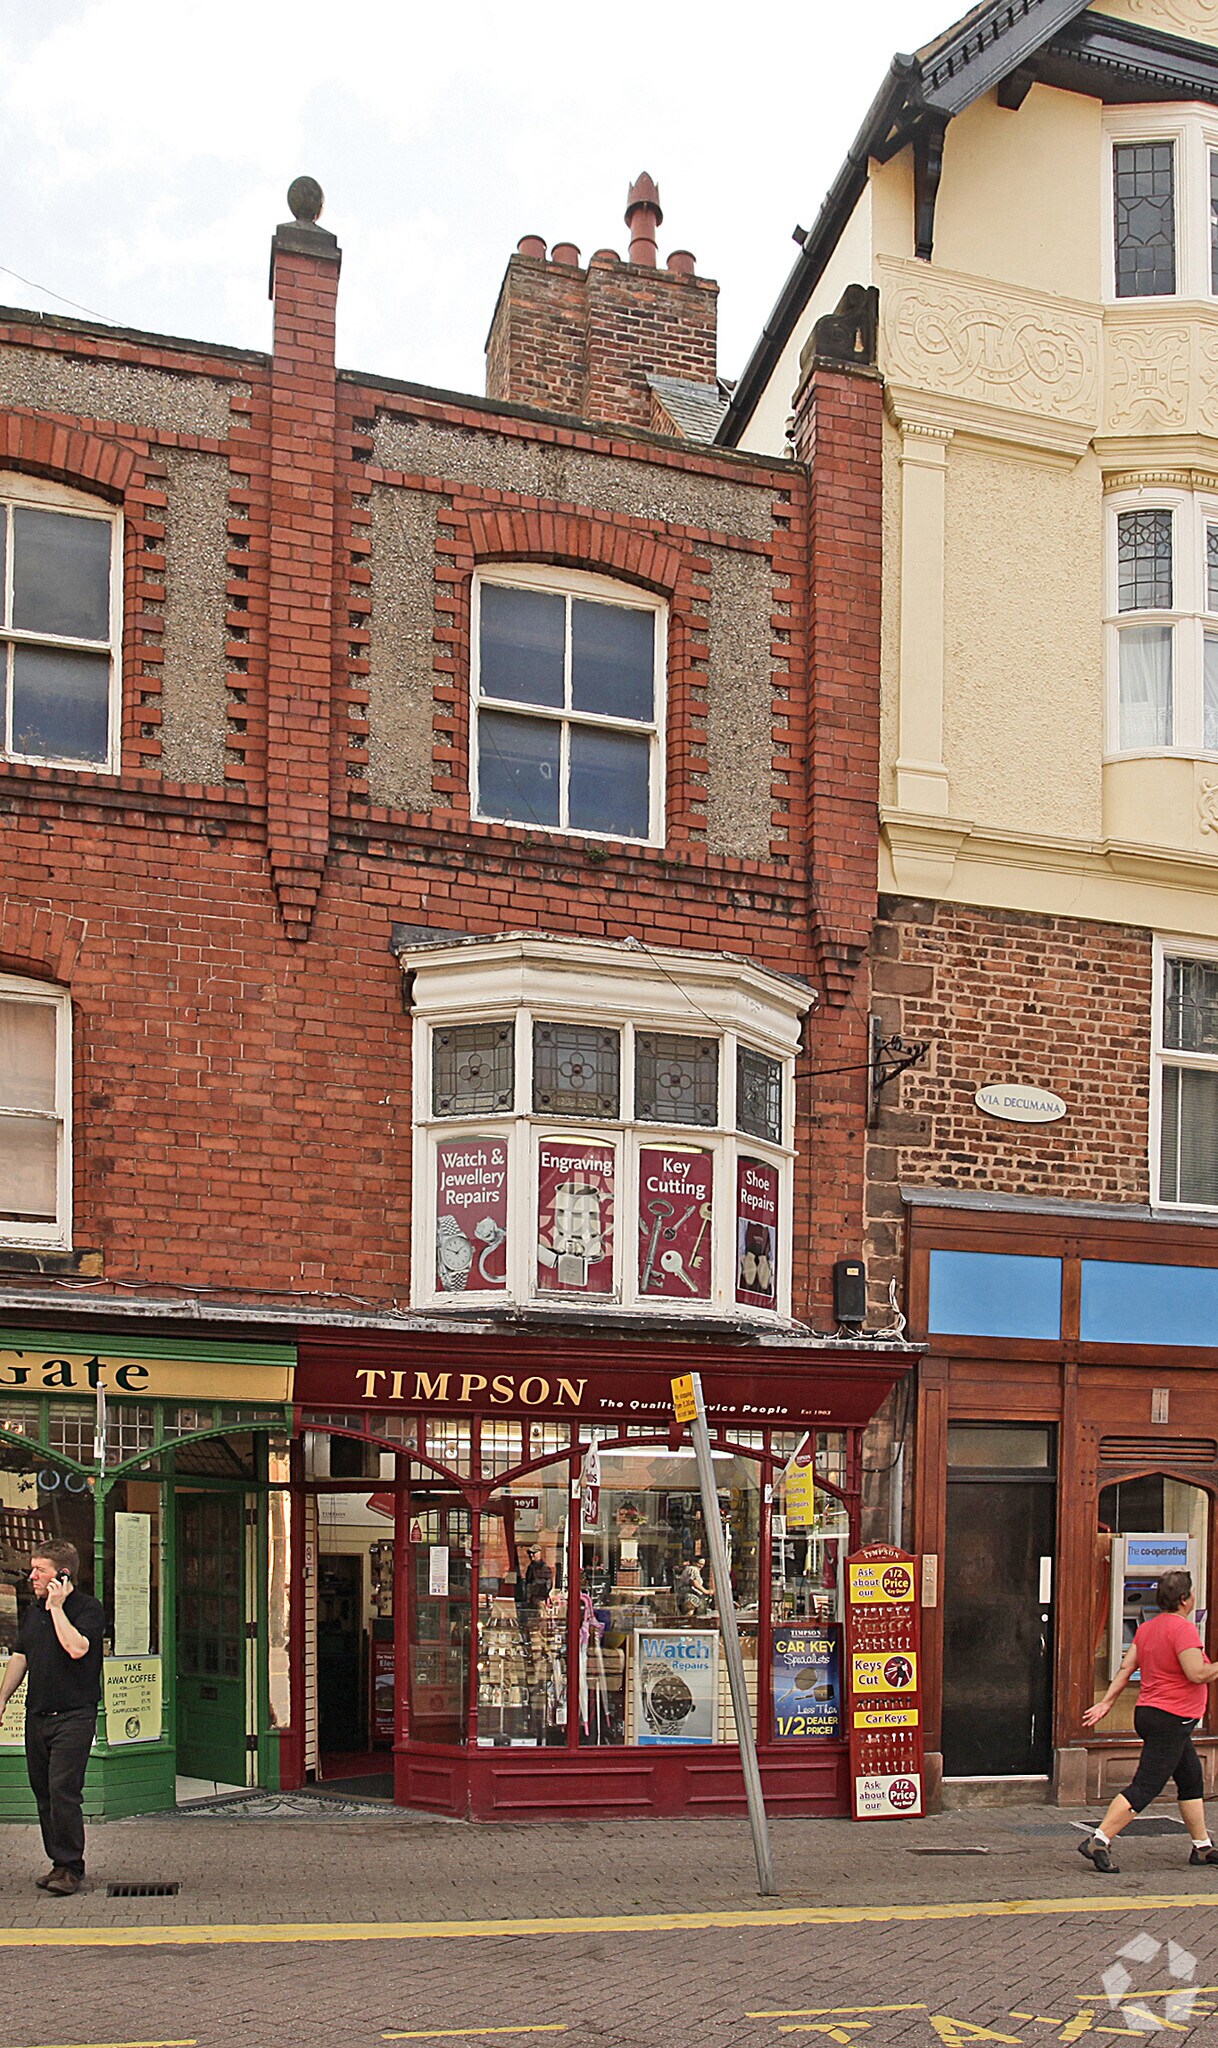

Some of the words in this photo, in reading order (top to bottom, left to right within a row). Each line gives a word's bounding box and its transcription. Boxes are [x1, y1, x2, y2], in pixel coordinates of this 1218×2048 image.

[981, 1094, 1000, 1106] VIA
[1004, 1097, 1061, 1113] DECUMANA
[441, 1150, 487, 1168] Watch
[491, 1148, 504, 1165] &
[541, 1152, 613, 1176] Engraving
[663, 1157, 691, 1178] Key
[440, 1169, 506, 1190] Jewellery
[746, 1170, 770, 1191] Shoe
[646, 1176, 706, 1200] Cutting
[446, 1189, 499, 1208] Repairs
[740, 1188, 775, 1213] Repairs
[356, 1369, 588, 1406] TIMPSON
[600, 1399, 624, 1408] The
[742, 1405, 788, 1414] People
[862, 1547, 900, 1558] TIMPSON
[1128, 1547, 1140, 1555] The
[1140, 1546, 1186, 1556] co-operative
[858, 1568, 874, 1576] Ask
[889, 1569, 902, 1578] 1/2
[853, 1578, 879, 1586] about
[884, 1578, 908, 1588] Price
[643, 1638, 710, 1659] Watch
[776, 1641, 806, 1653] CAR
[810, 1641, 836, 1652] KEY
[672, 1660, 709, 1671] Repairs
[784, 1654, 830, 1667] Specialists
[855, 1660, 882, 1671] Keys
[124, 1663, 142, 1671] TAKE
[107, 1676, 128, 1685] AWAY
[130, 1674, 156, 1683] COFFEE
[858, 1675, 878, 1684] Cut
[797, 1704, 815, 1714] Less
[866, 1714, 882, 1724] Car
[885, 1714, 907, 1723] Keys
[777, 1716, 806, 1736] 1/2
[807, 1727, 833, 1735] PRICE!
[896, 1781, 909, 1790] 1/2
[859, 1791, 886, 1800] about
[890, 1790, 916, 1800] Price
